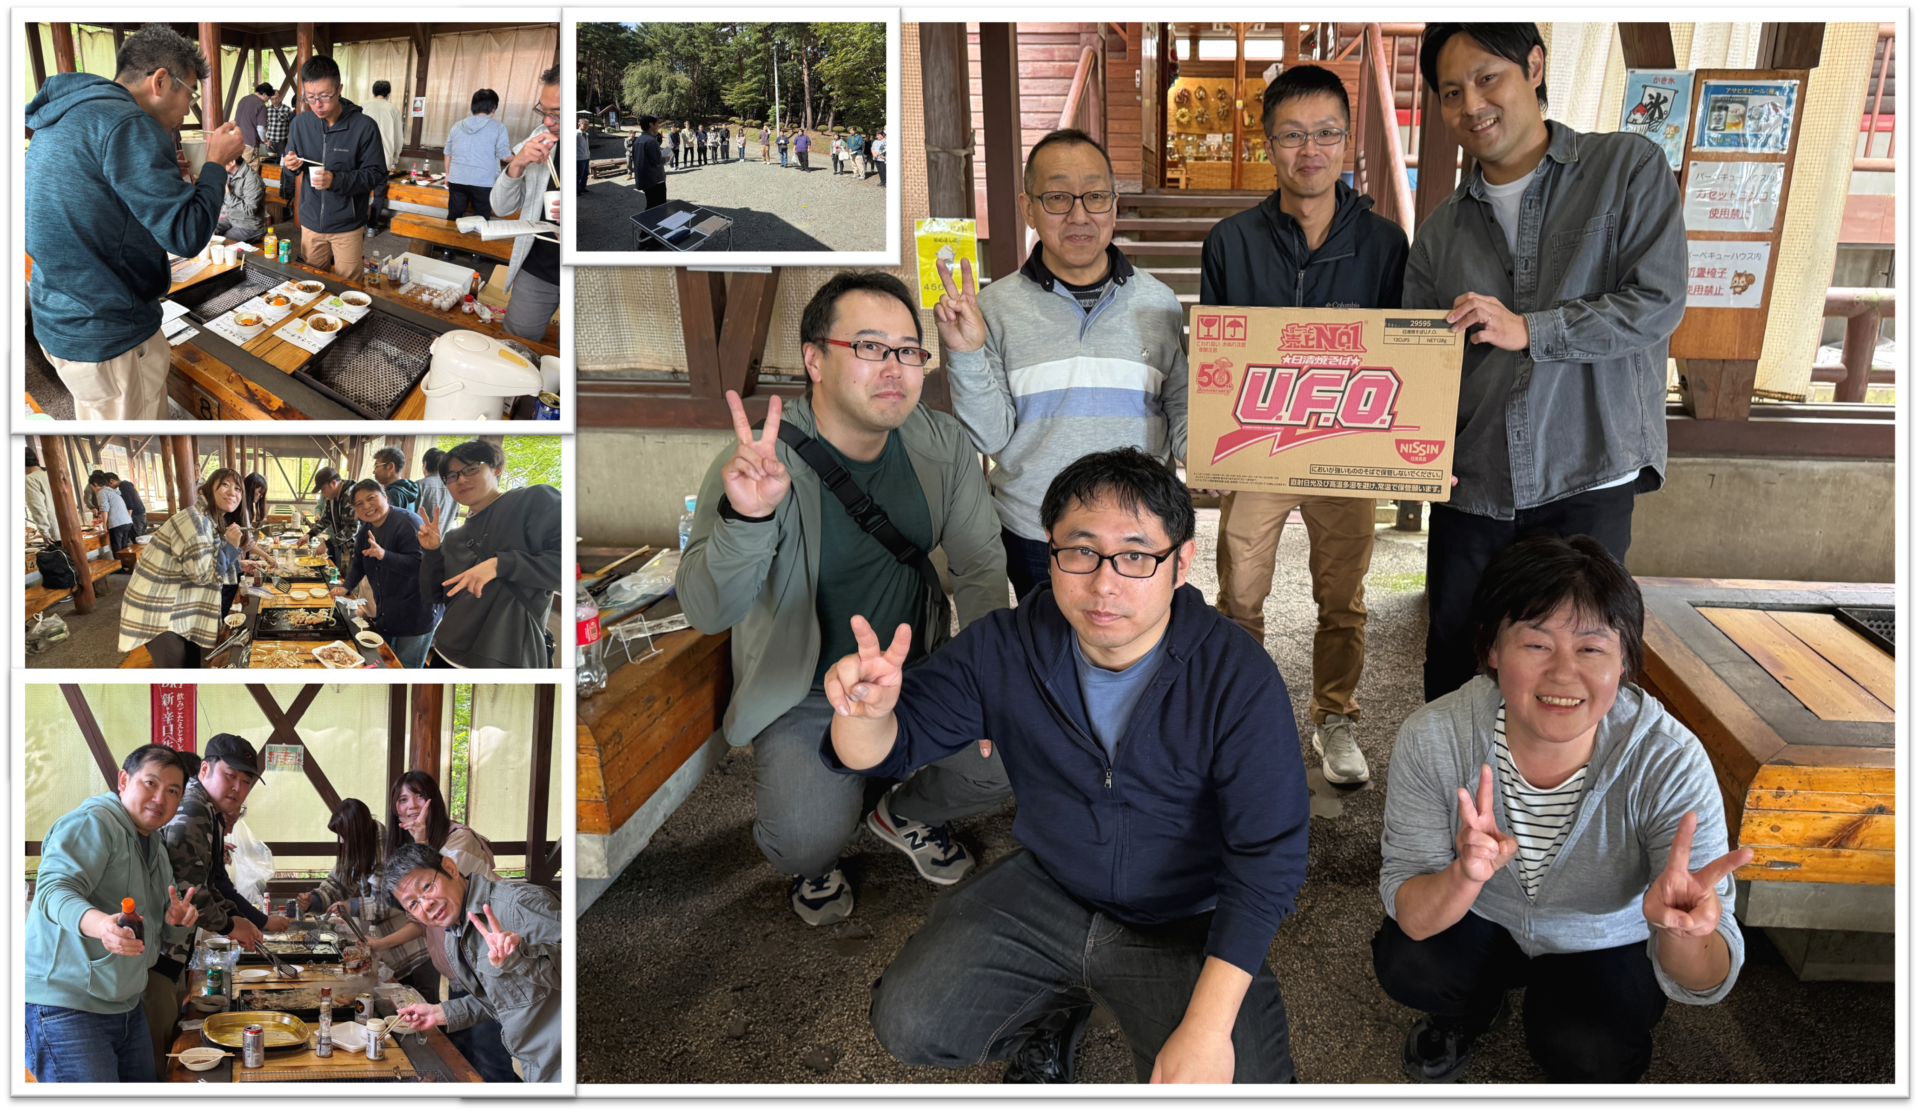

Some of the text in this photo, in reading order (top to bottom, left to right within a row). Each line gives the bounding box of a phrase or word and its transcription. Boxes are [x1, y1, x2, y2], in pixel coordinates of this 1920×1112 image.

[1653, 76, 1676, 85] かき氷
[1410, 319, 1432, 327] 29595
[1235, 367, 1401, 430] U.F.O.
[1400, 441, 1439, 456] NISSIN
